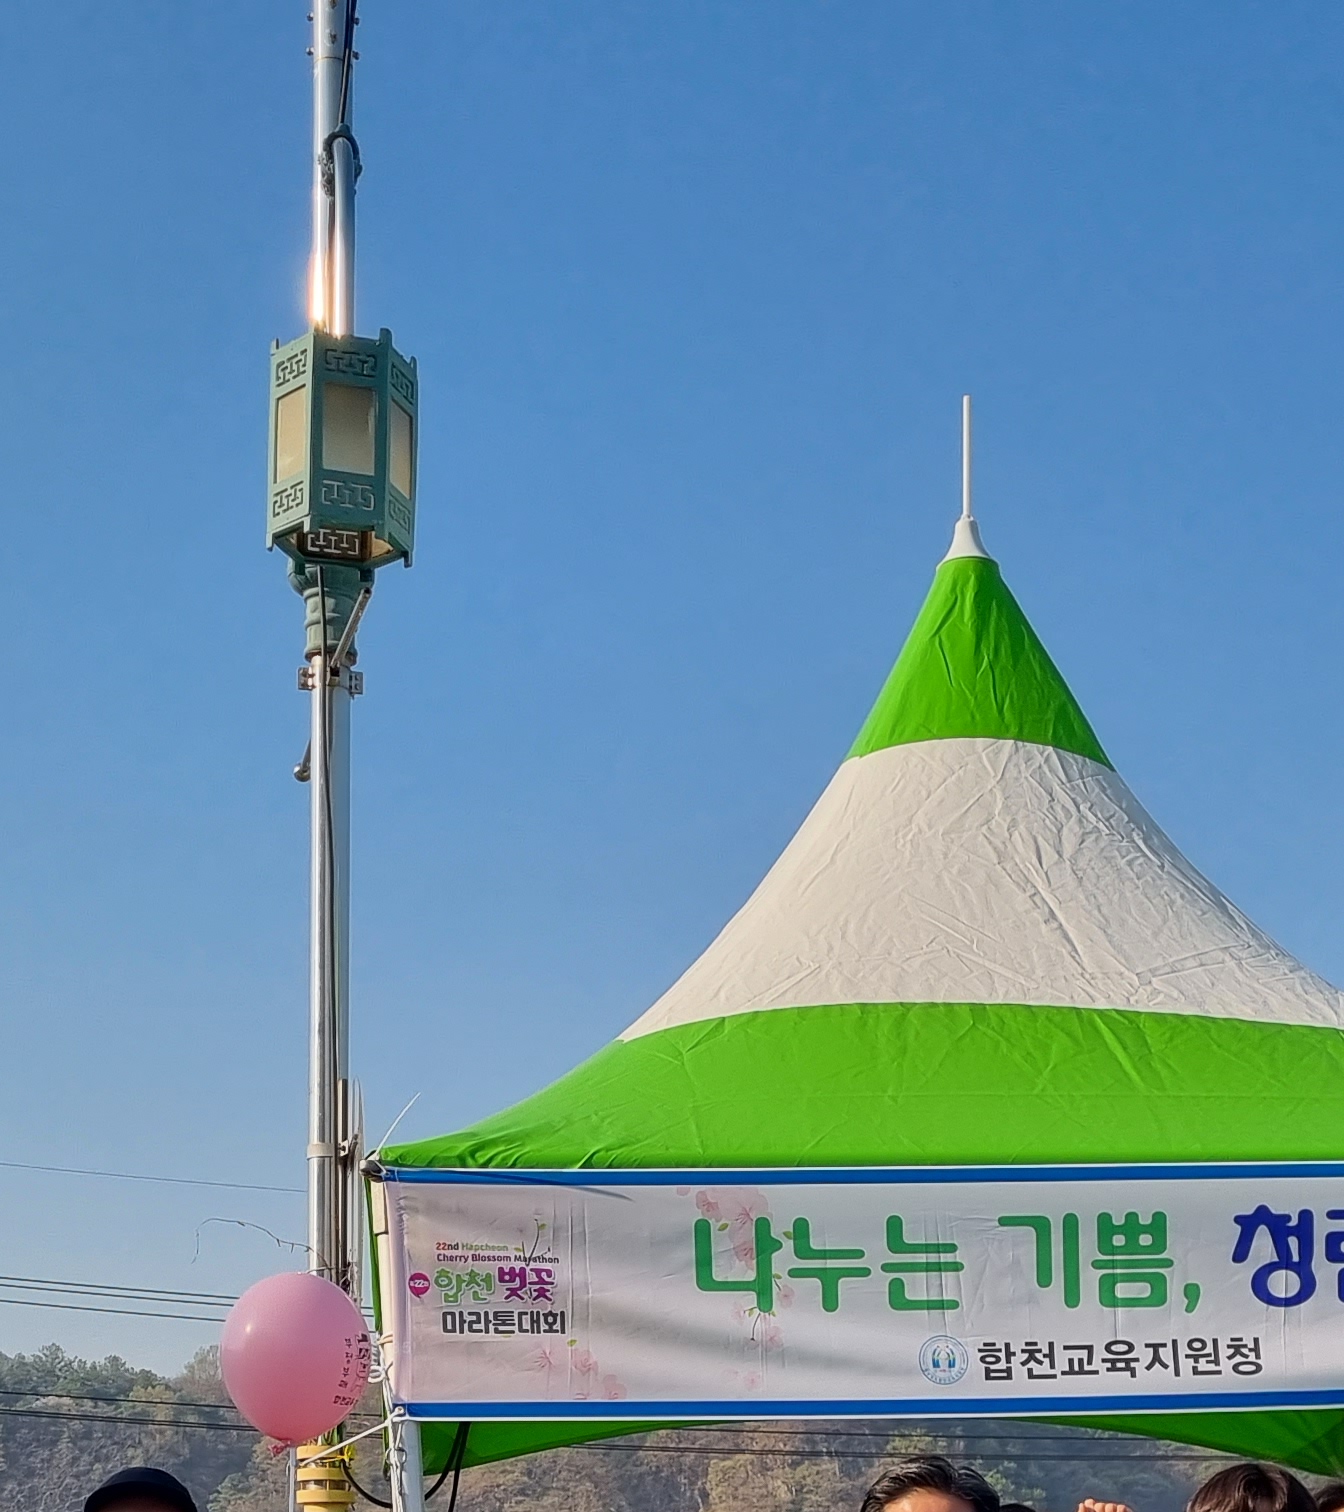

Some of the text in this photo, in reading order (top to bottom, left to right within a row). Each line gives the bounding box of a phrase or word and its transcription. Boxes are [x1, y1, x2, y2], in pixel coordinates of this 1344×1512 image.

[435, 1242, 508, 1253] 22nd Hapcheon
[436, 1253, 471, 1264] Cherry
[471, 1254, 512, 1263] Blossom
[693, 1213, 965, 1313] 나누는
[997, 1210, 1202, 1315] 기쁨,
[434, 1266, 555, 1304] 합천 벚꽃
[441, 1310, 567, 1335] 마라톤대회
[978, 1337, 1263, 1382] 합천교육지원청
